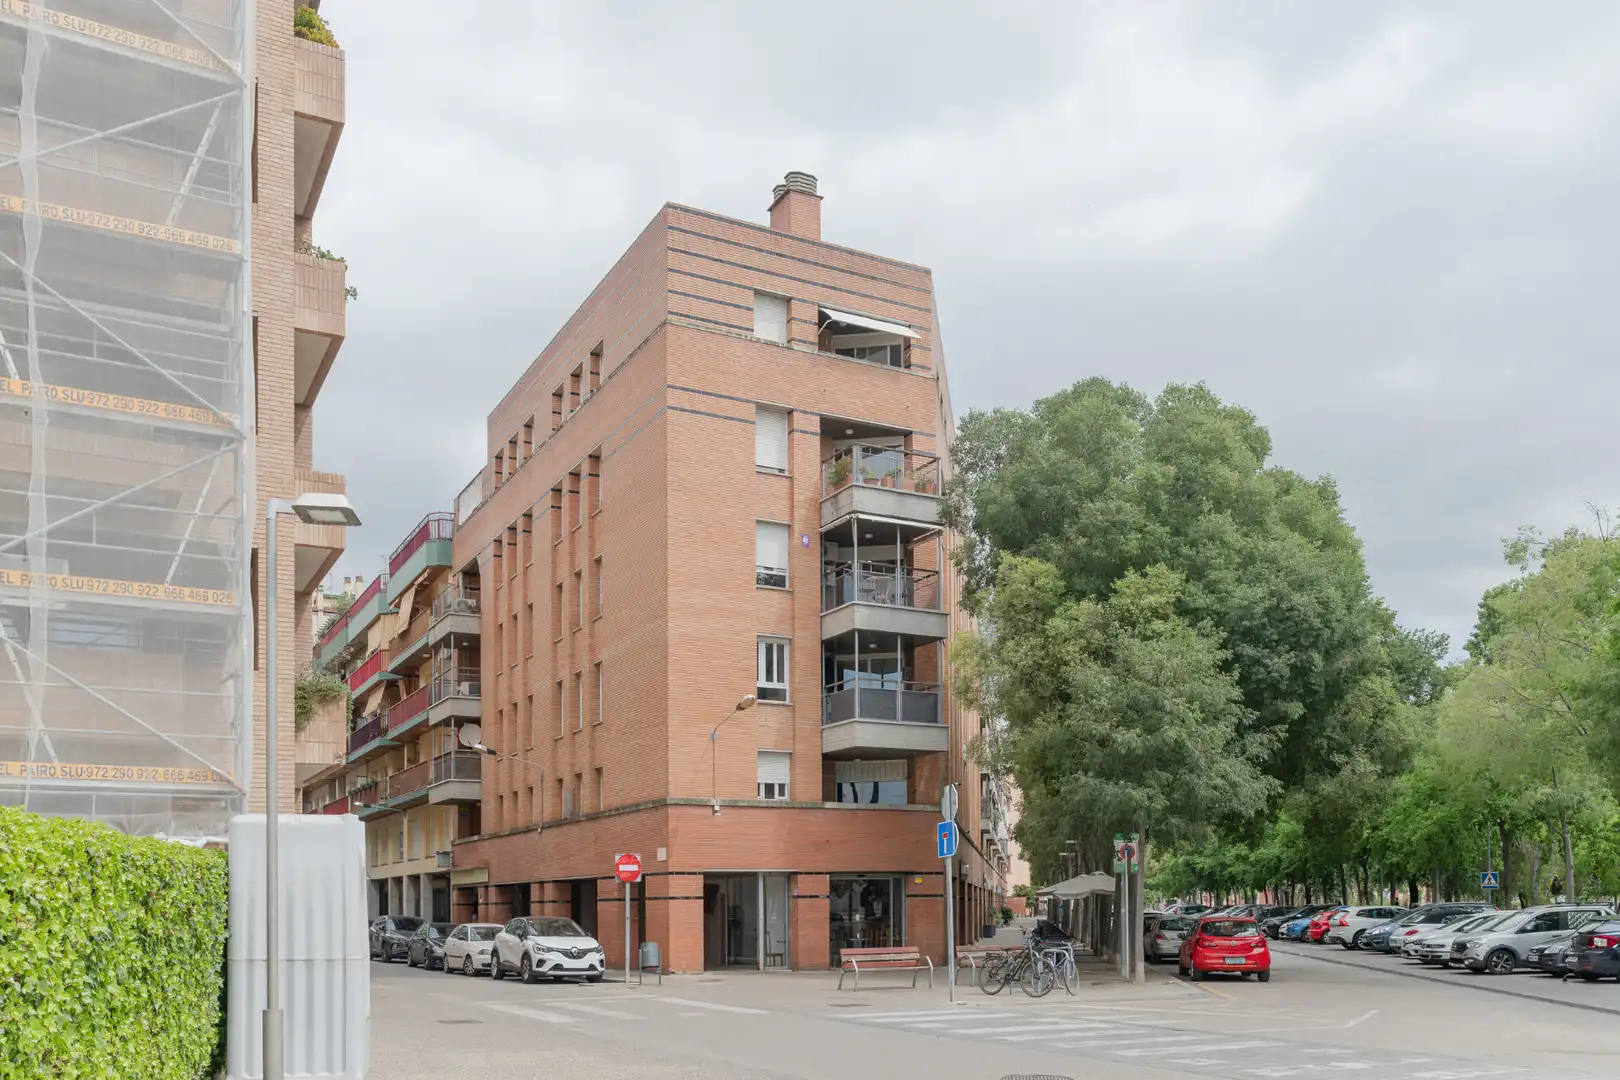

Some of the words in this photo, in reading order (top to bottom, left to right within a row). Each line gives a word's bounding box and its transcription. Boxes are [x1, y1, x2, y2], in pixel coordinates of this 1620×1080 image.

[113, 218, 135, 232] 290
[212, 237, 233, 252] 026
[113, 396, 135, 411] 290
[188, 409, 209, 422] 469
[113, 581, 134, 595] 290
[212, 591, 233, 604] 026
[112, 767, 134, 780] 290
[187, 769, 208, 782] 469
